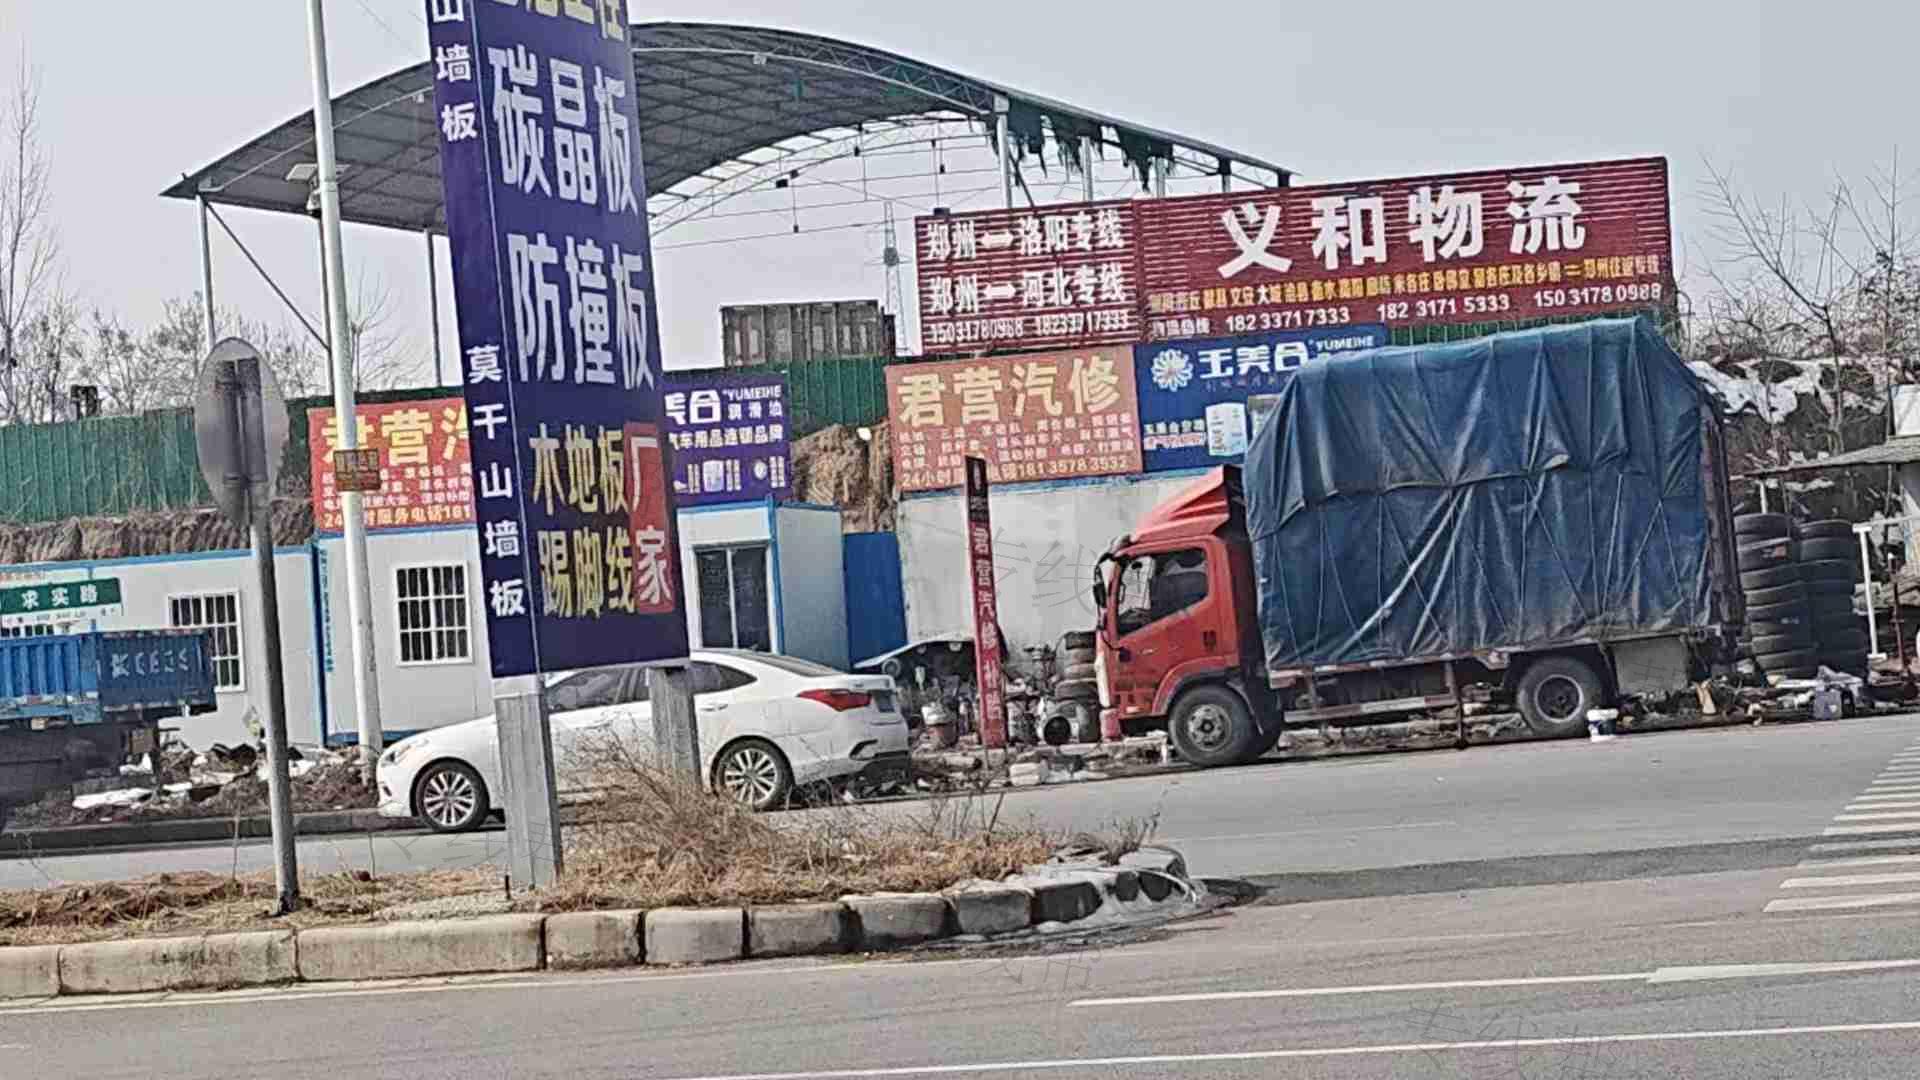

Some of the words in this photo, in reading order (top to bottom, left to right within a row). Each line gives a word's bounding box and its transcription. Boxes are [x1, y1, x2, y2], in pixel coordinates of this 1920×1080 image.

[487, 44, 639, 216] 碳晶板
[927, 220, 977, 261] 郑州
[1019, 209, 1125, 256] 洛阳专线
[1217, 176, 1586, 278] 义和物流
[507, 232, 655, 390] 防撞板
[929, 274, 978, 314] 郑州
[1022, 263, 1126, 307] 河北专线
[898, 355, 1120, 428] 君营汽修
[529, 422, 628, 516] 木地板
[537, 525, 636, 618] 踢脚线
